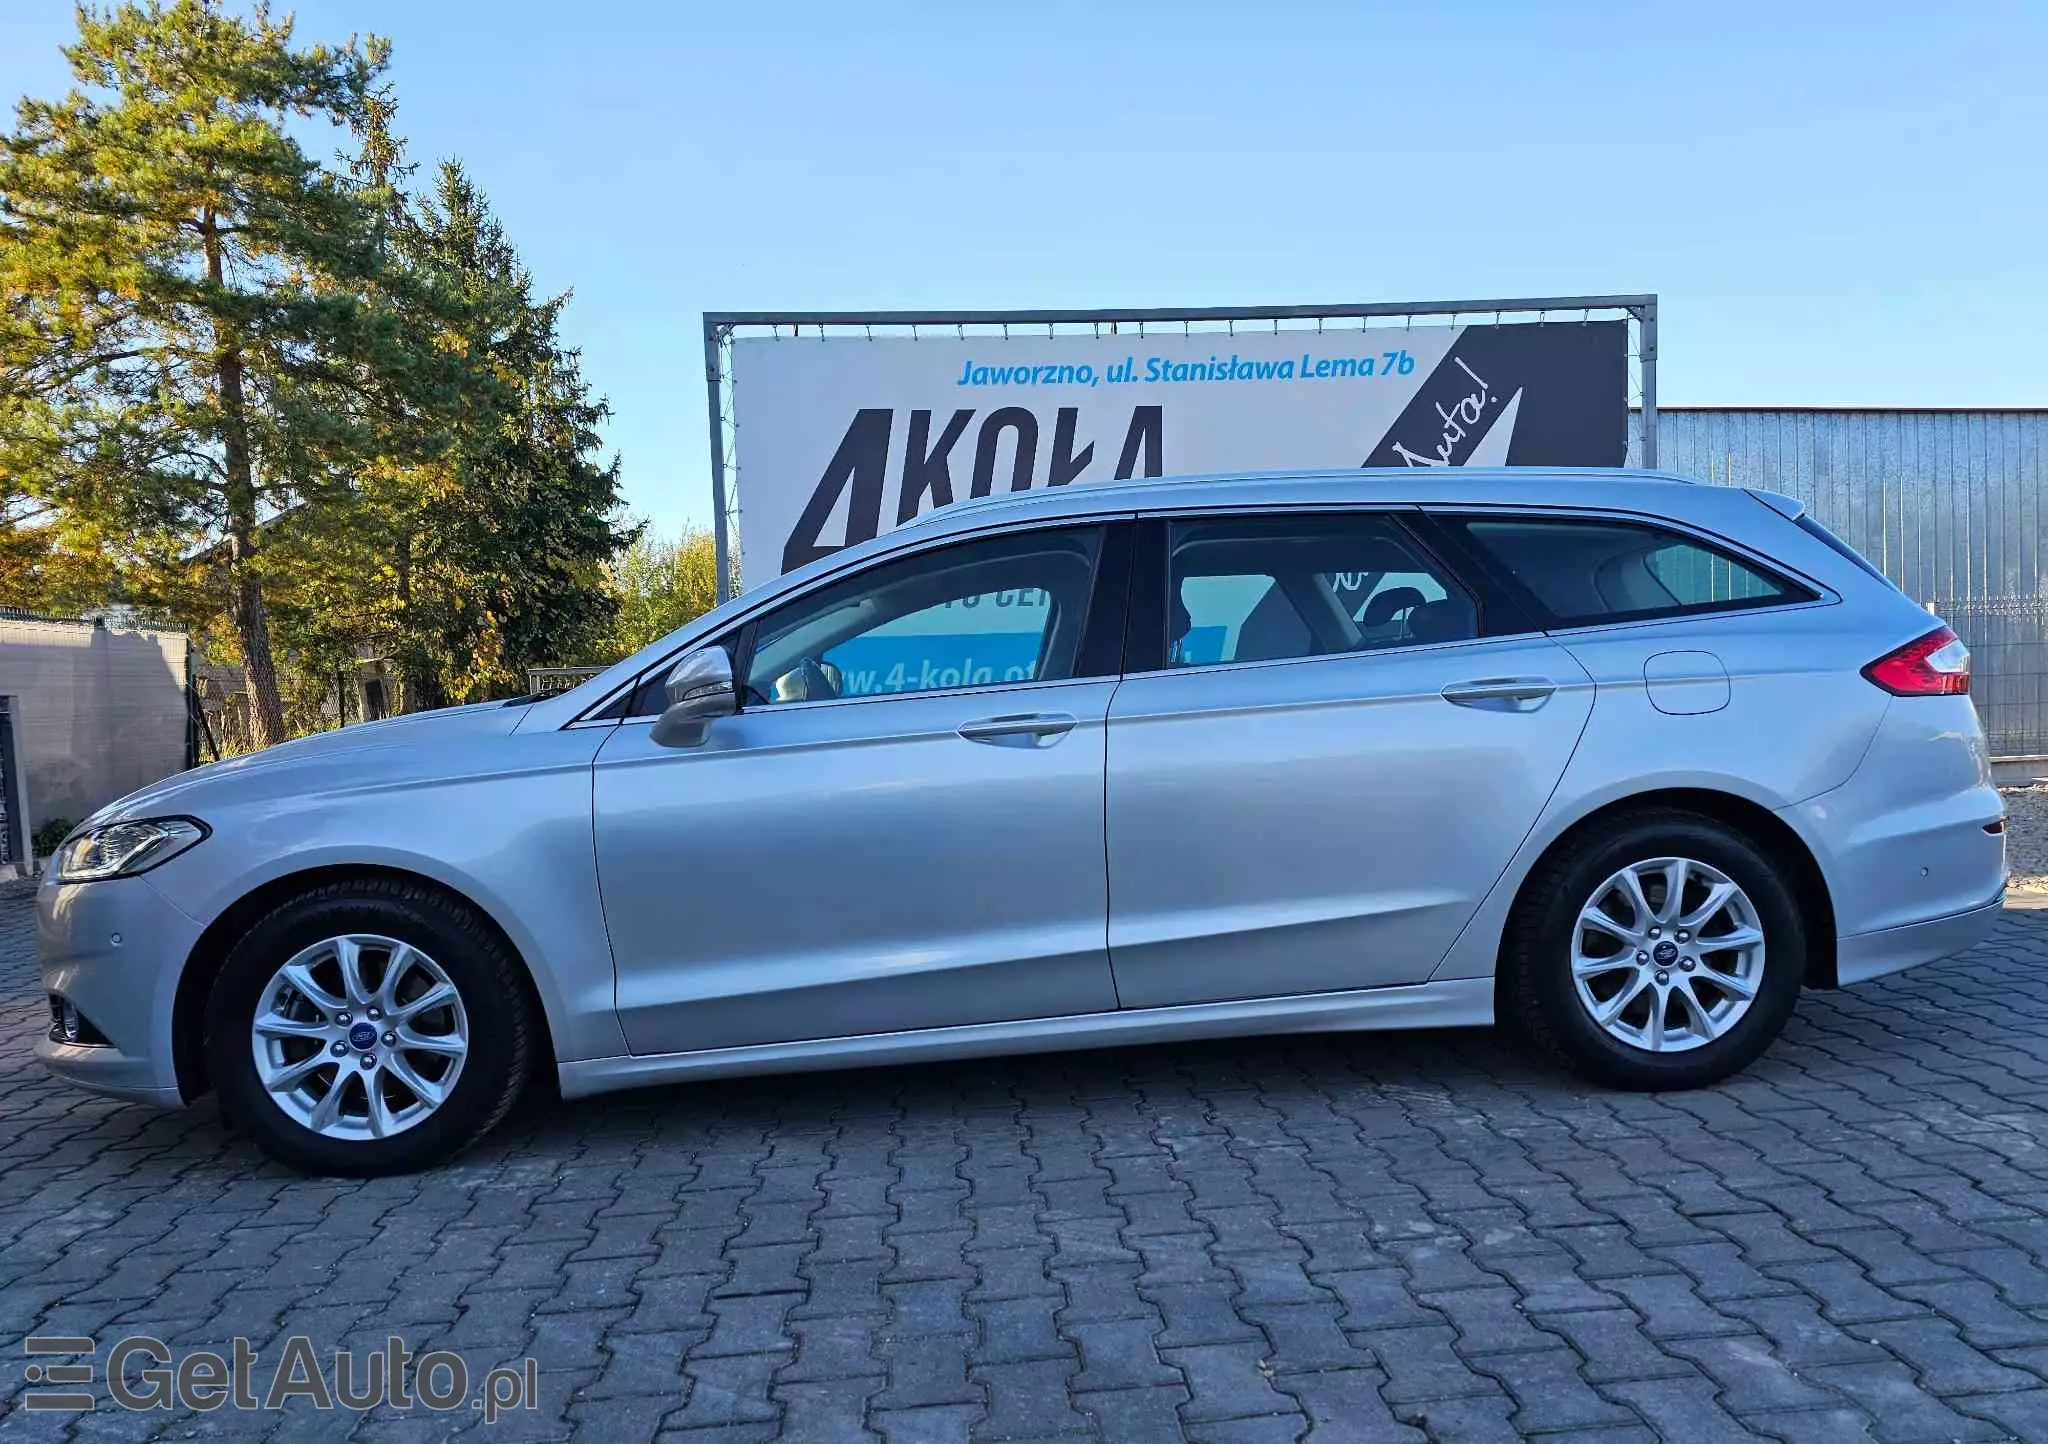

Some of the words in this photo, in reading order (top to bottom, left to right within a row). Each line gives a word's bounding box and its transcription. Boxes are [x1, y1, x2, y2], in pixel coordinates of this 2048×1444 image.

[957, 360, 1101, 387] Jaworzno,
[1106, 356, 1138, 383] ul.
[1145, 354, 1295, 383] Stanisława
[1299, 353, 1375, 378] Lema
[1380, 349, 1415, 376] 7b
[1391, 356, 1498, 466] Auta!
